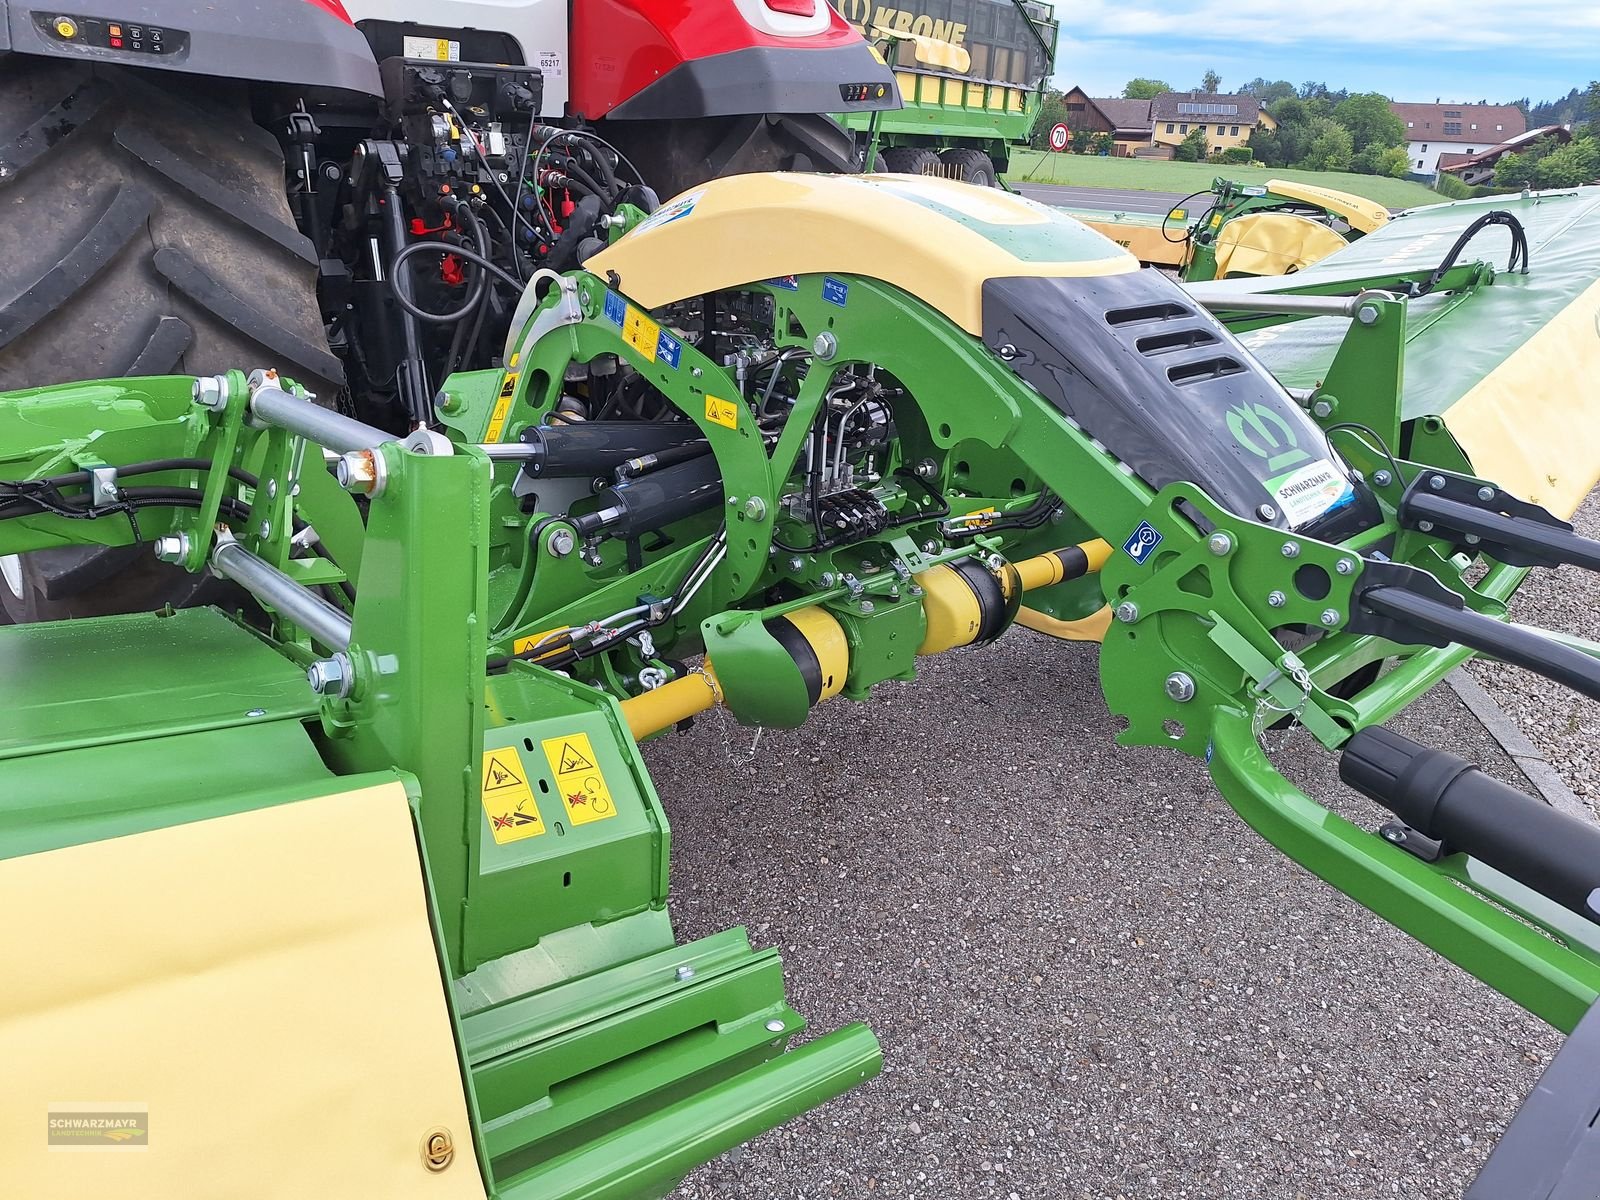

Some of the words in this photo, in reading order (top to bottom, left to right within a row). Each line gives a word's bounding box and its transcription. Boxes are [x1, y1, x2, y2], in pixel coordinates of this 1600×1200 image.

[870, 6, 967, 47] KRONE
[1055, 130, 1064, 144] 70
[1279, 471, 1332, 499] SCHWARZMAYR
